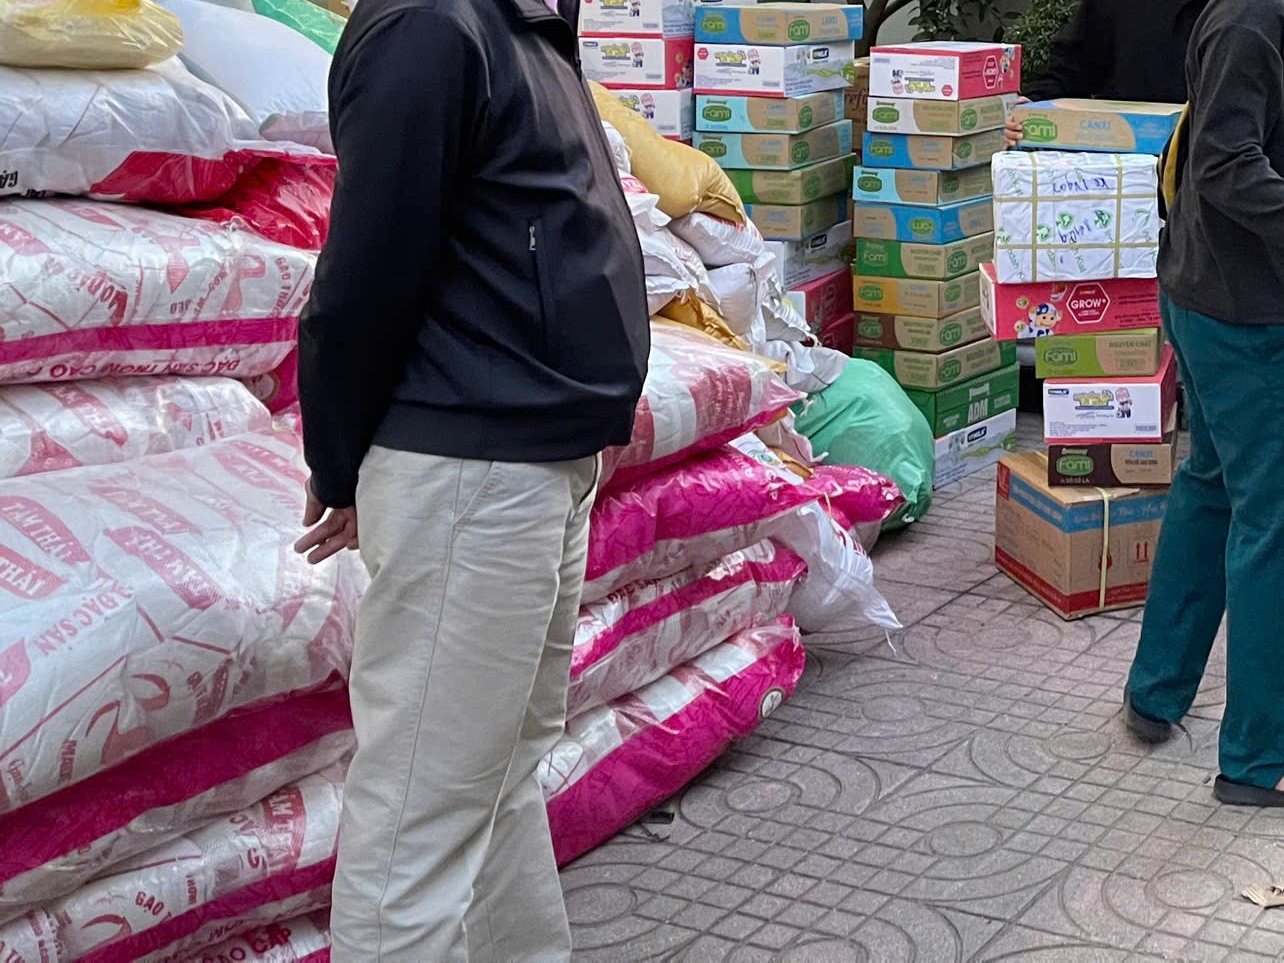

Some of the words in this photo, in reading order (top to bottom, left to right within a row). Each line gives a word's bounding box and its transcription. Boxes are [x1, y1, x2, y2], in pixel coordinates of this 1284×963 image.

[1044, 351, 1078, 363] Fami
[968, 398, 989, 424] ADM
[1060, 458, 1091, 472] Fami
[135, 890, 163, 917] GẠO
